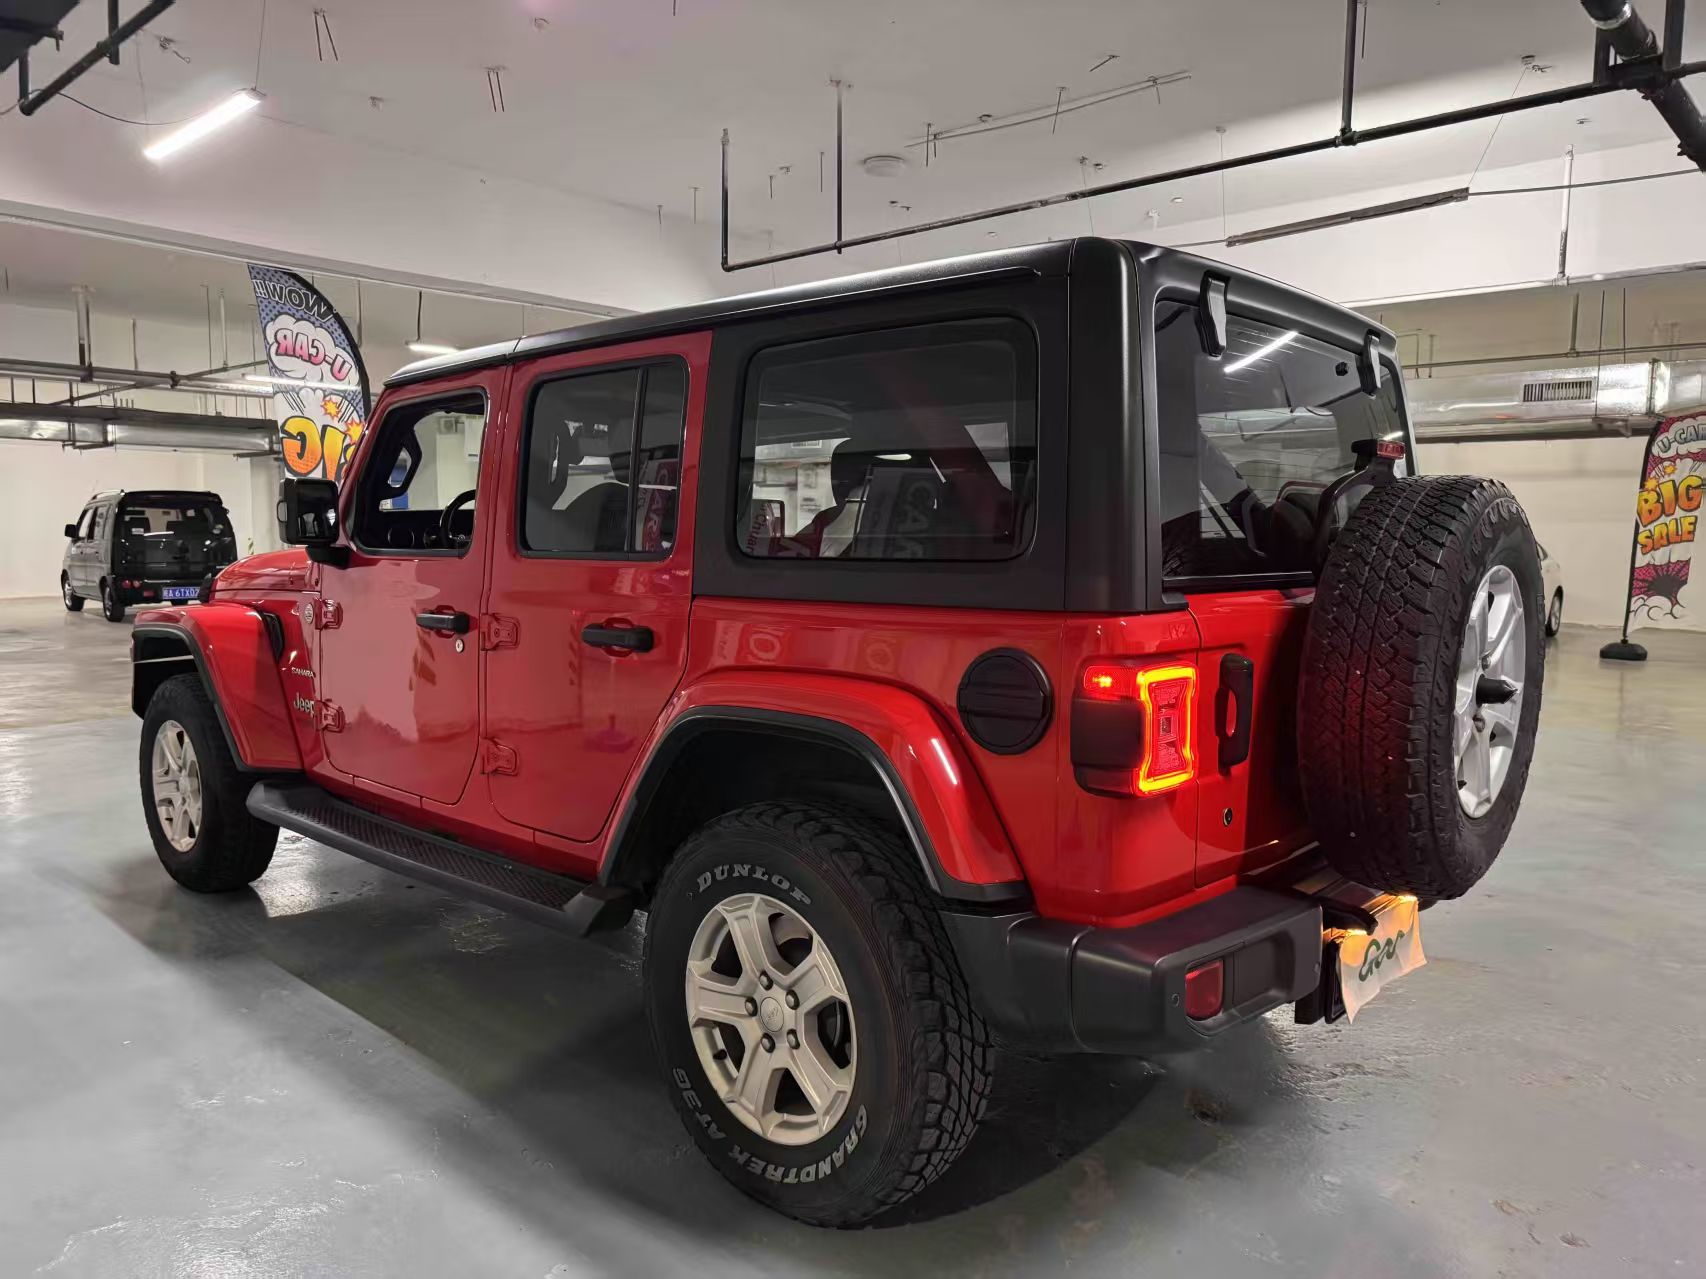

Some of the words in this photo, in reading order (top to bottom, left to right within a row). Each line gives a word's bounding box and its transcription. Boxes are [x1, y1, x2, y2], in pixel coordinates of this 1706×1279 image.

[1637, 475, 1703, 527] BIG
[1637, 515, 1698, 555] SALE
[291, 666, 315, 678] SAHARA
[294, 692, 315, 718] Jeep
[697, 863, 811, 905] DUNLOP
[728, 1103, 867, 1184] GRANDTREK
